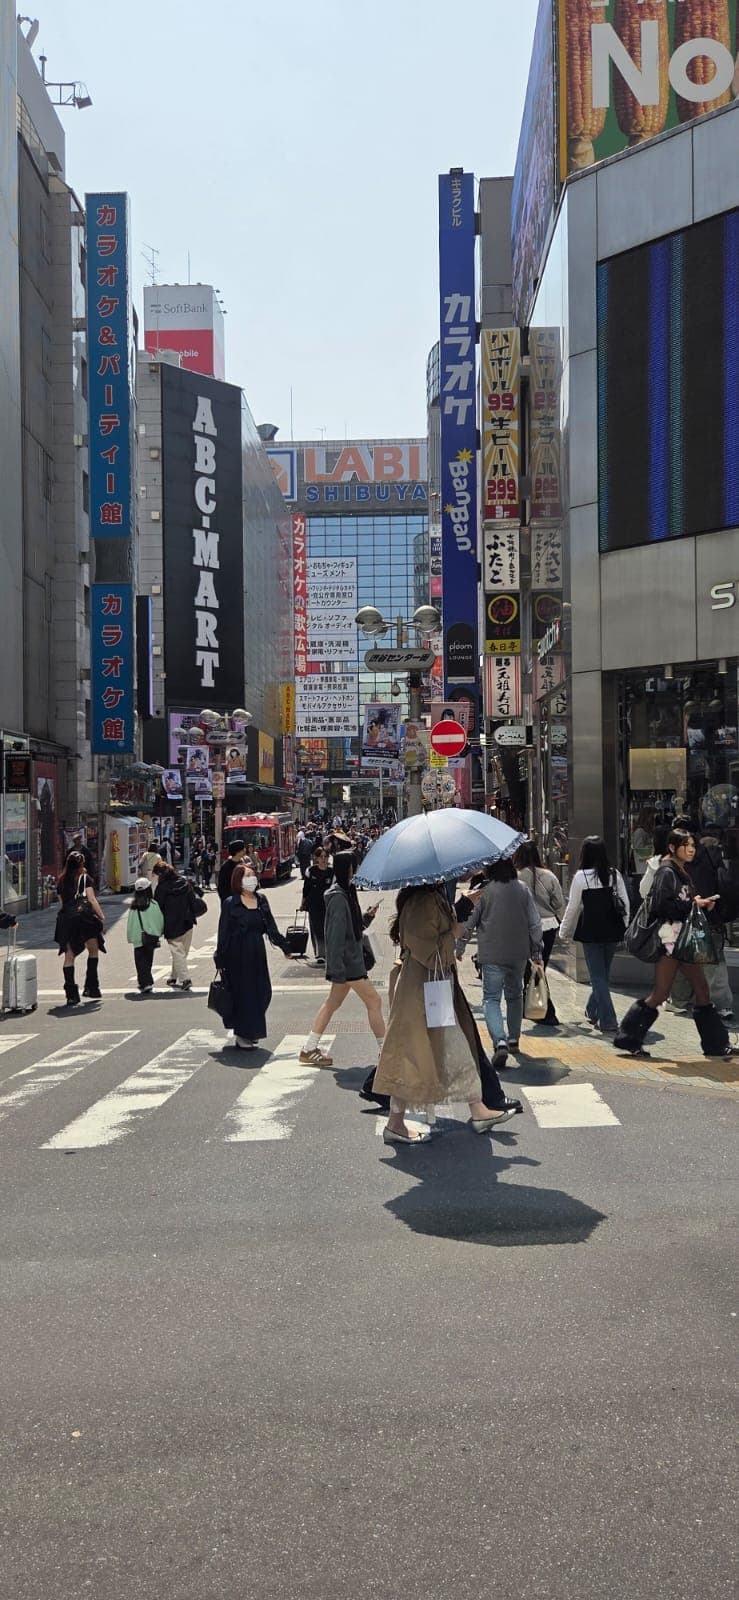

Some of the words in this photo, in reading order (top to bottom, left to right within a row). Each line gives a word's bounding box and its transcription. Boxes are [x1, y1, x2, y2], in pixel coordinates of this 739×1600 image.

[163, 303, 207, 314] SoftBank
[96, 204, 122, 525] カラオケ&パーティー館
[443, 293, 473, 425] カラオケ
[489, 334, 512, 392] ハイボール
[304, 446, 421, 482] LABI
[491, 416, 511, 477] 生ビール
[305, 484, 427, 501] SHIBUYA
[448, 461, 472, 552] BanBan
[487, 479, 516, 501] 299
[495, 505, 510, 519] 3F
[192, 395, 220, 687] ABC-MART
[101, 593, 124, 741] カラオケ館
[449, 640, 473, 653] ploom
[496, 667, 511, 715] 元祖寿司
